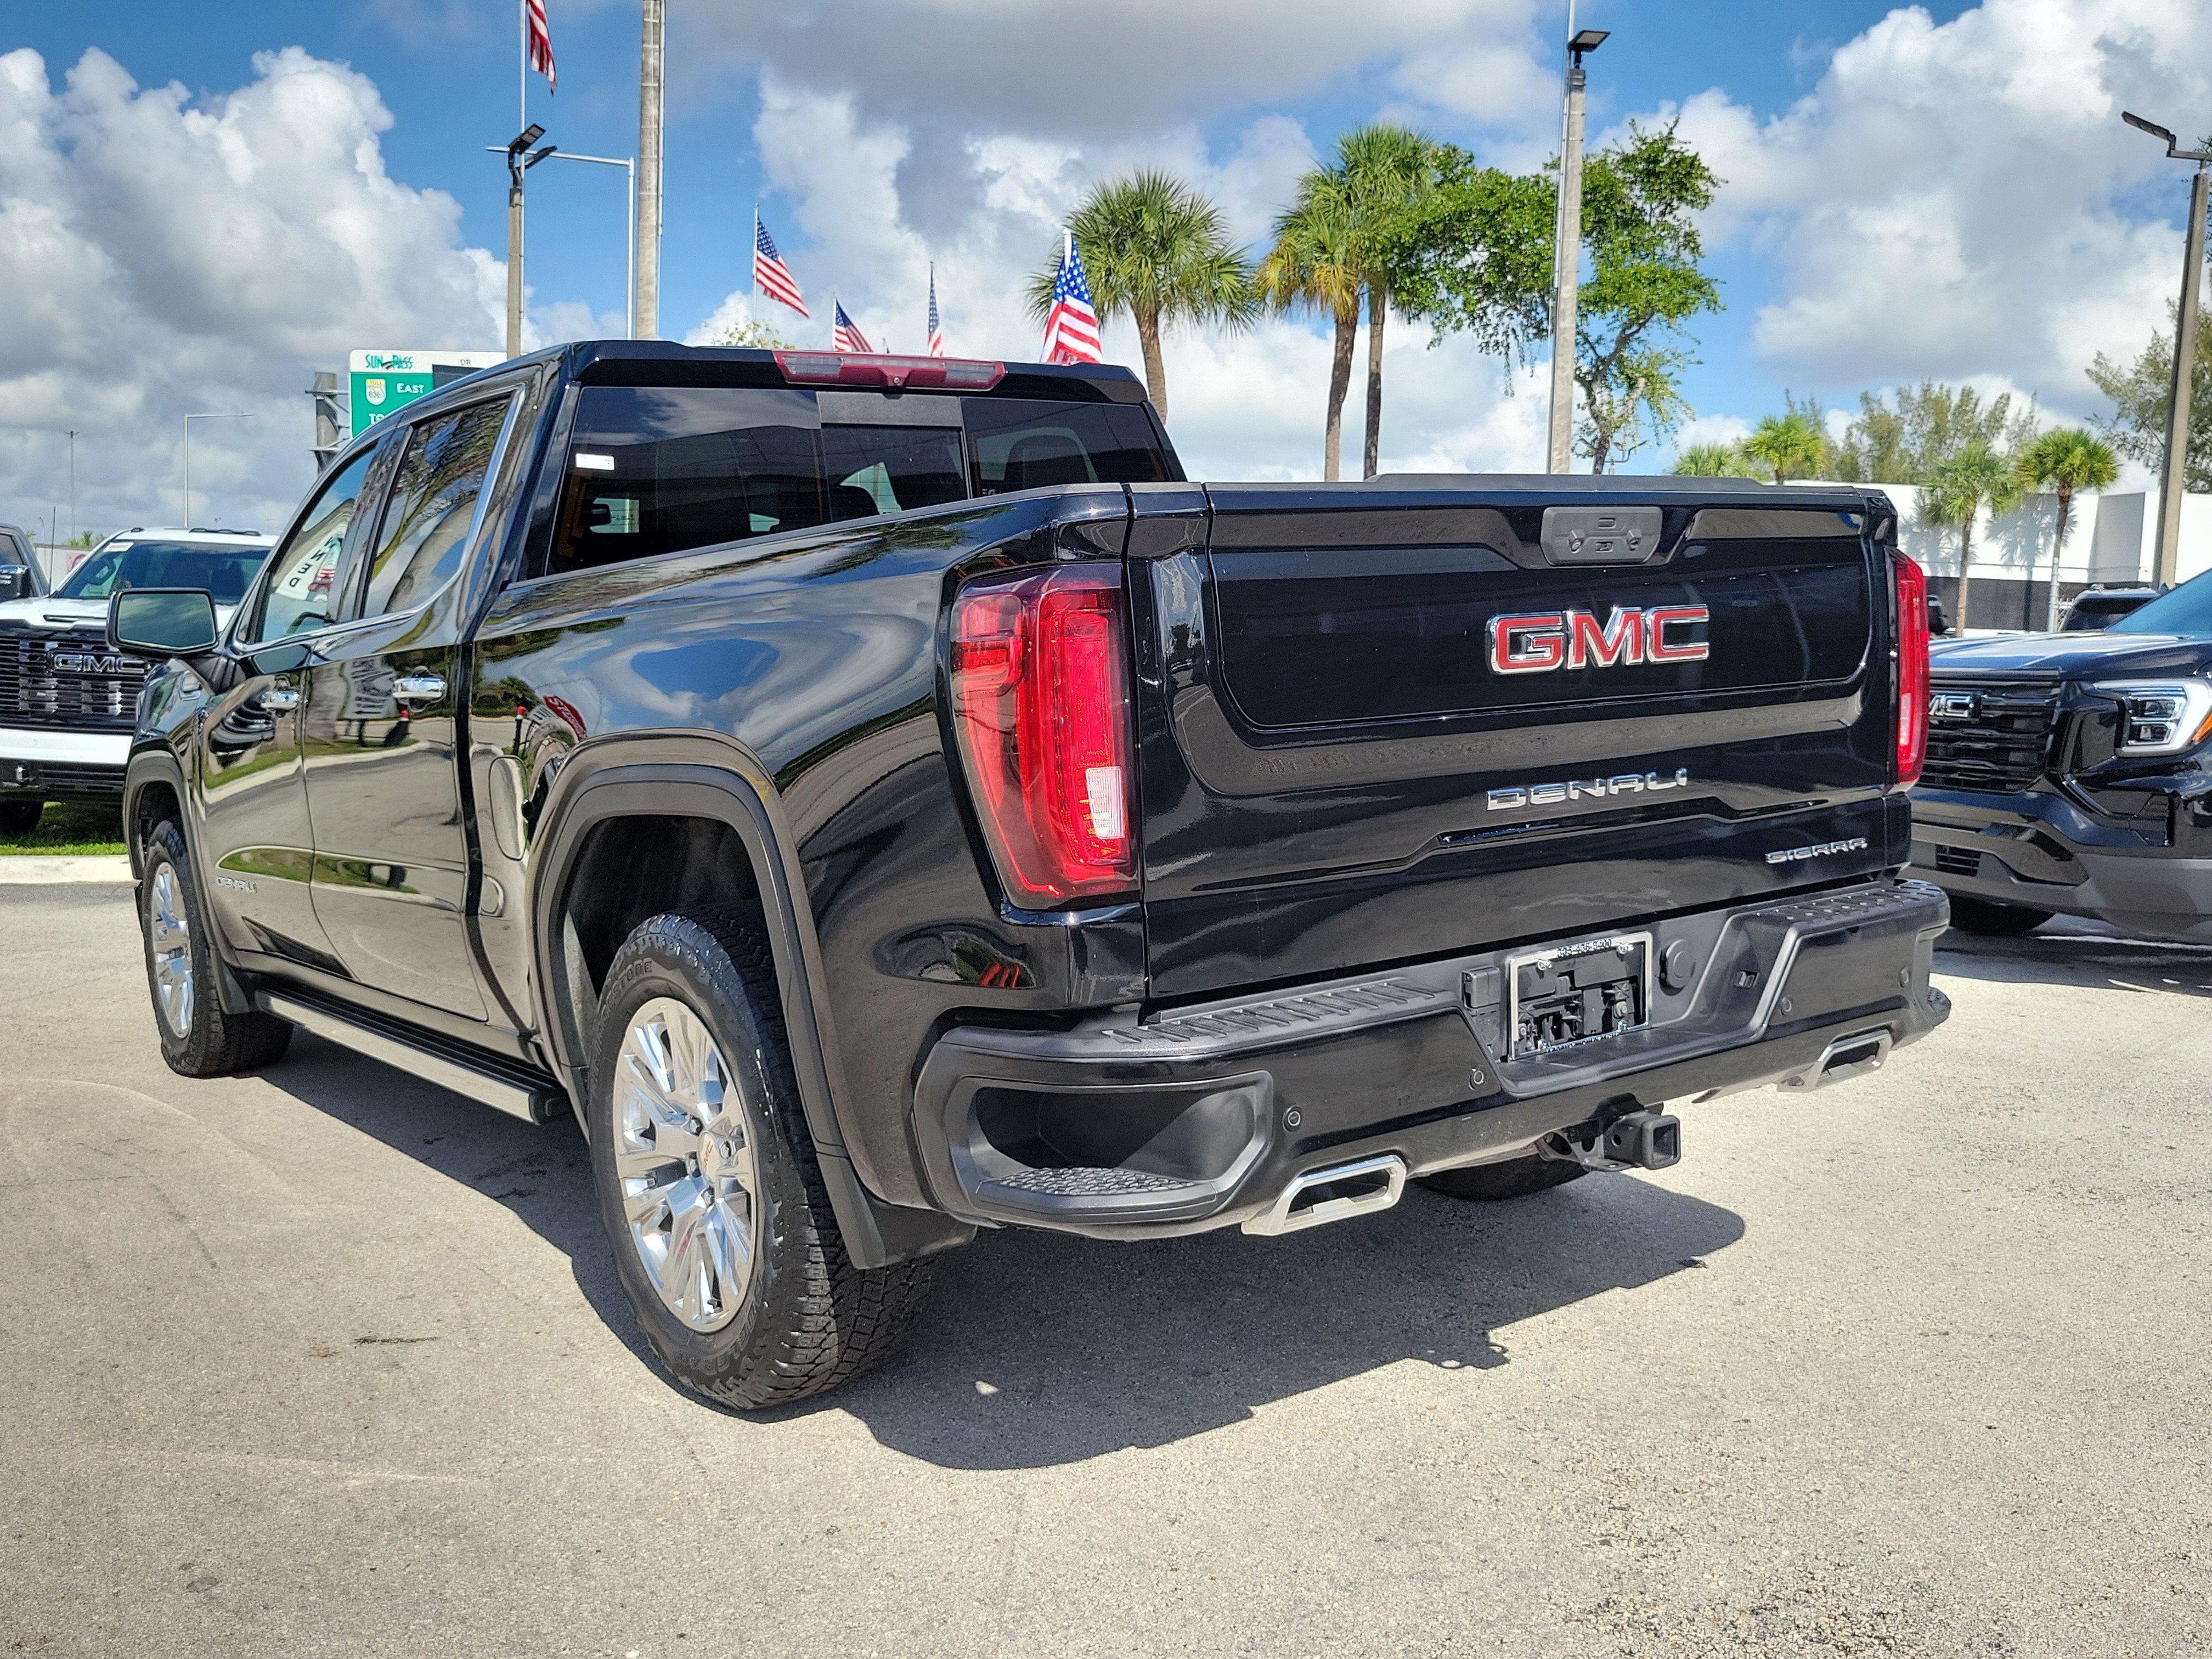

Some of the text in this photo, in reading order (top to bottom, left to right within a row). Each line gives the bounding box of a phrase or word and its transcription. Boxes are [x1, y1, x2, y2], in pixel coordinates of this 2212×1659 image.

[397, 382, 425, 394] EAST
[1486, 604, 1709, 674] GMC
[54, 654, 146, 674] GMC
[1928, 695, 1970, 718] MC
[1487, 768, 1687, 810] DENALI
[1765, 837, 1868, 864] SIERRA
